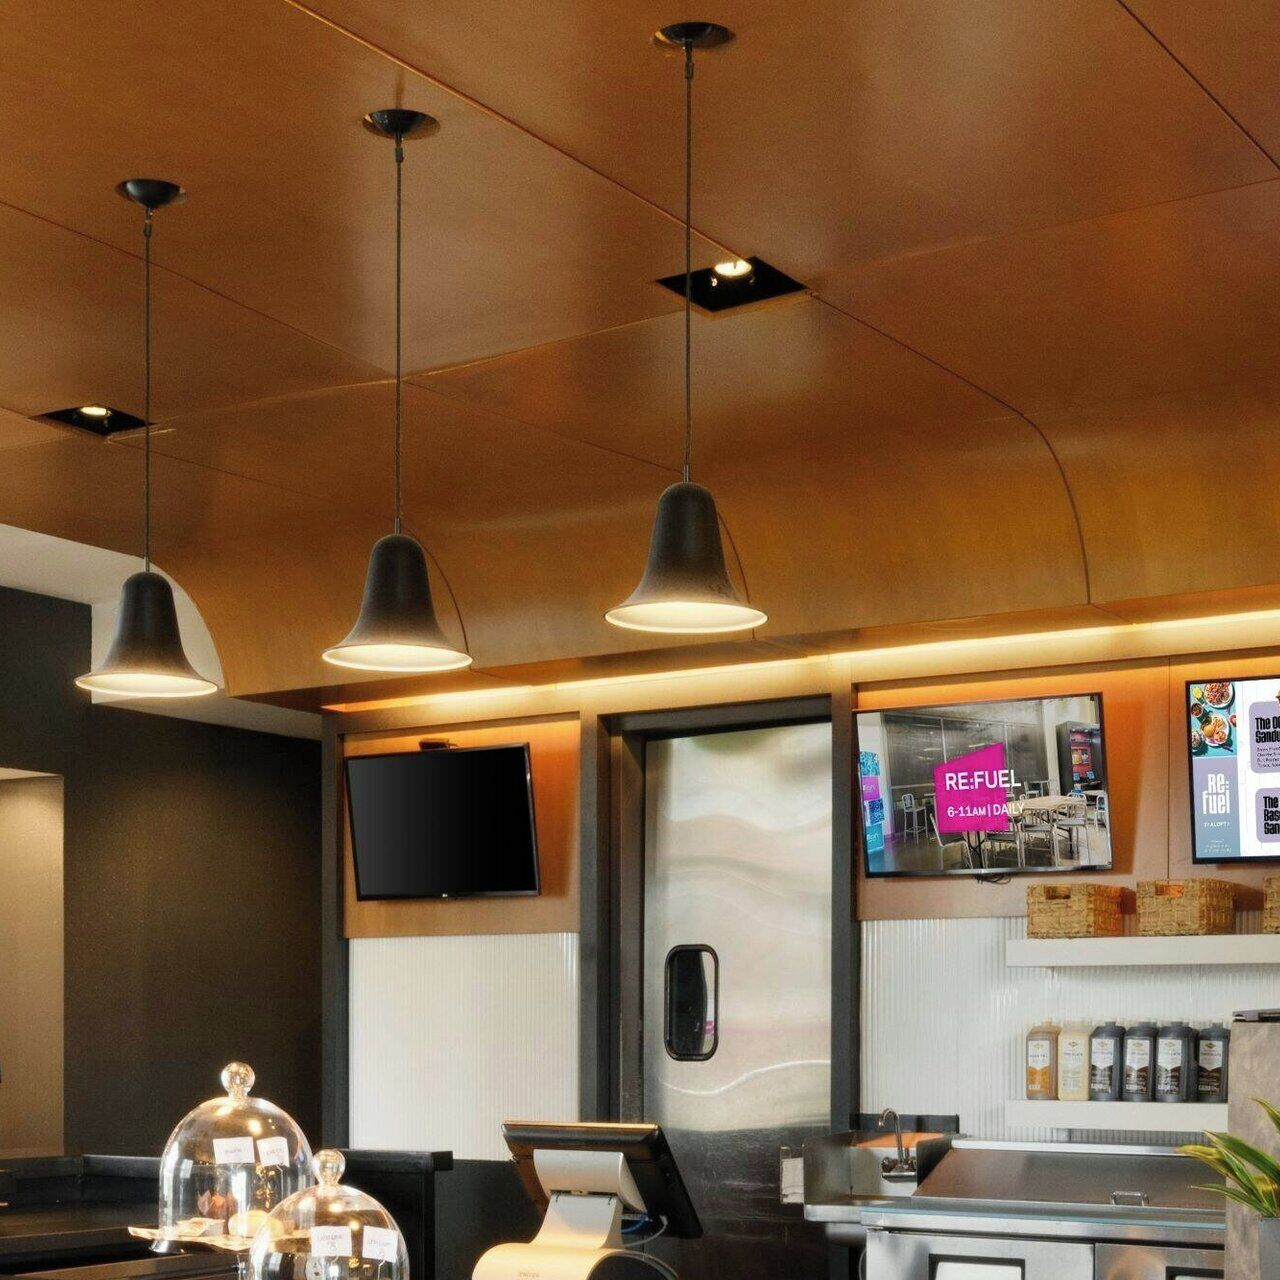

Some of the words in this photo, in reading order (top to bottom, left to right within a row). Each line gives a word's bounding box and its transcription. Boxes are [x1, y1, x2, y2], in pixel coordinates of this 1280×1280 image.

[1255, 716, 1271, 730] The
[944, 769, 1022, 791] RE:FUEL
[1207, 773, 1230, 794] Re:
[993, 803, 1025, 816] DAILY
[1202, 789, 1230, 815] fuel
[1263, 795, 1280, 809] The
